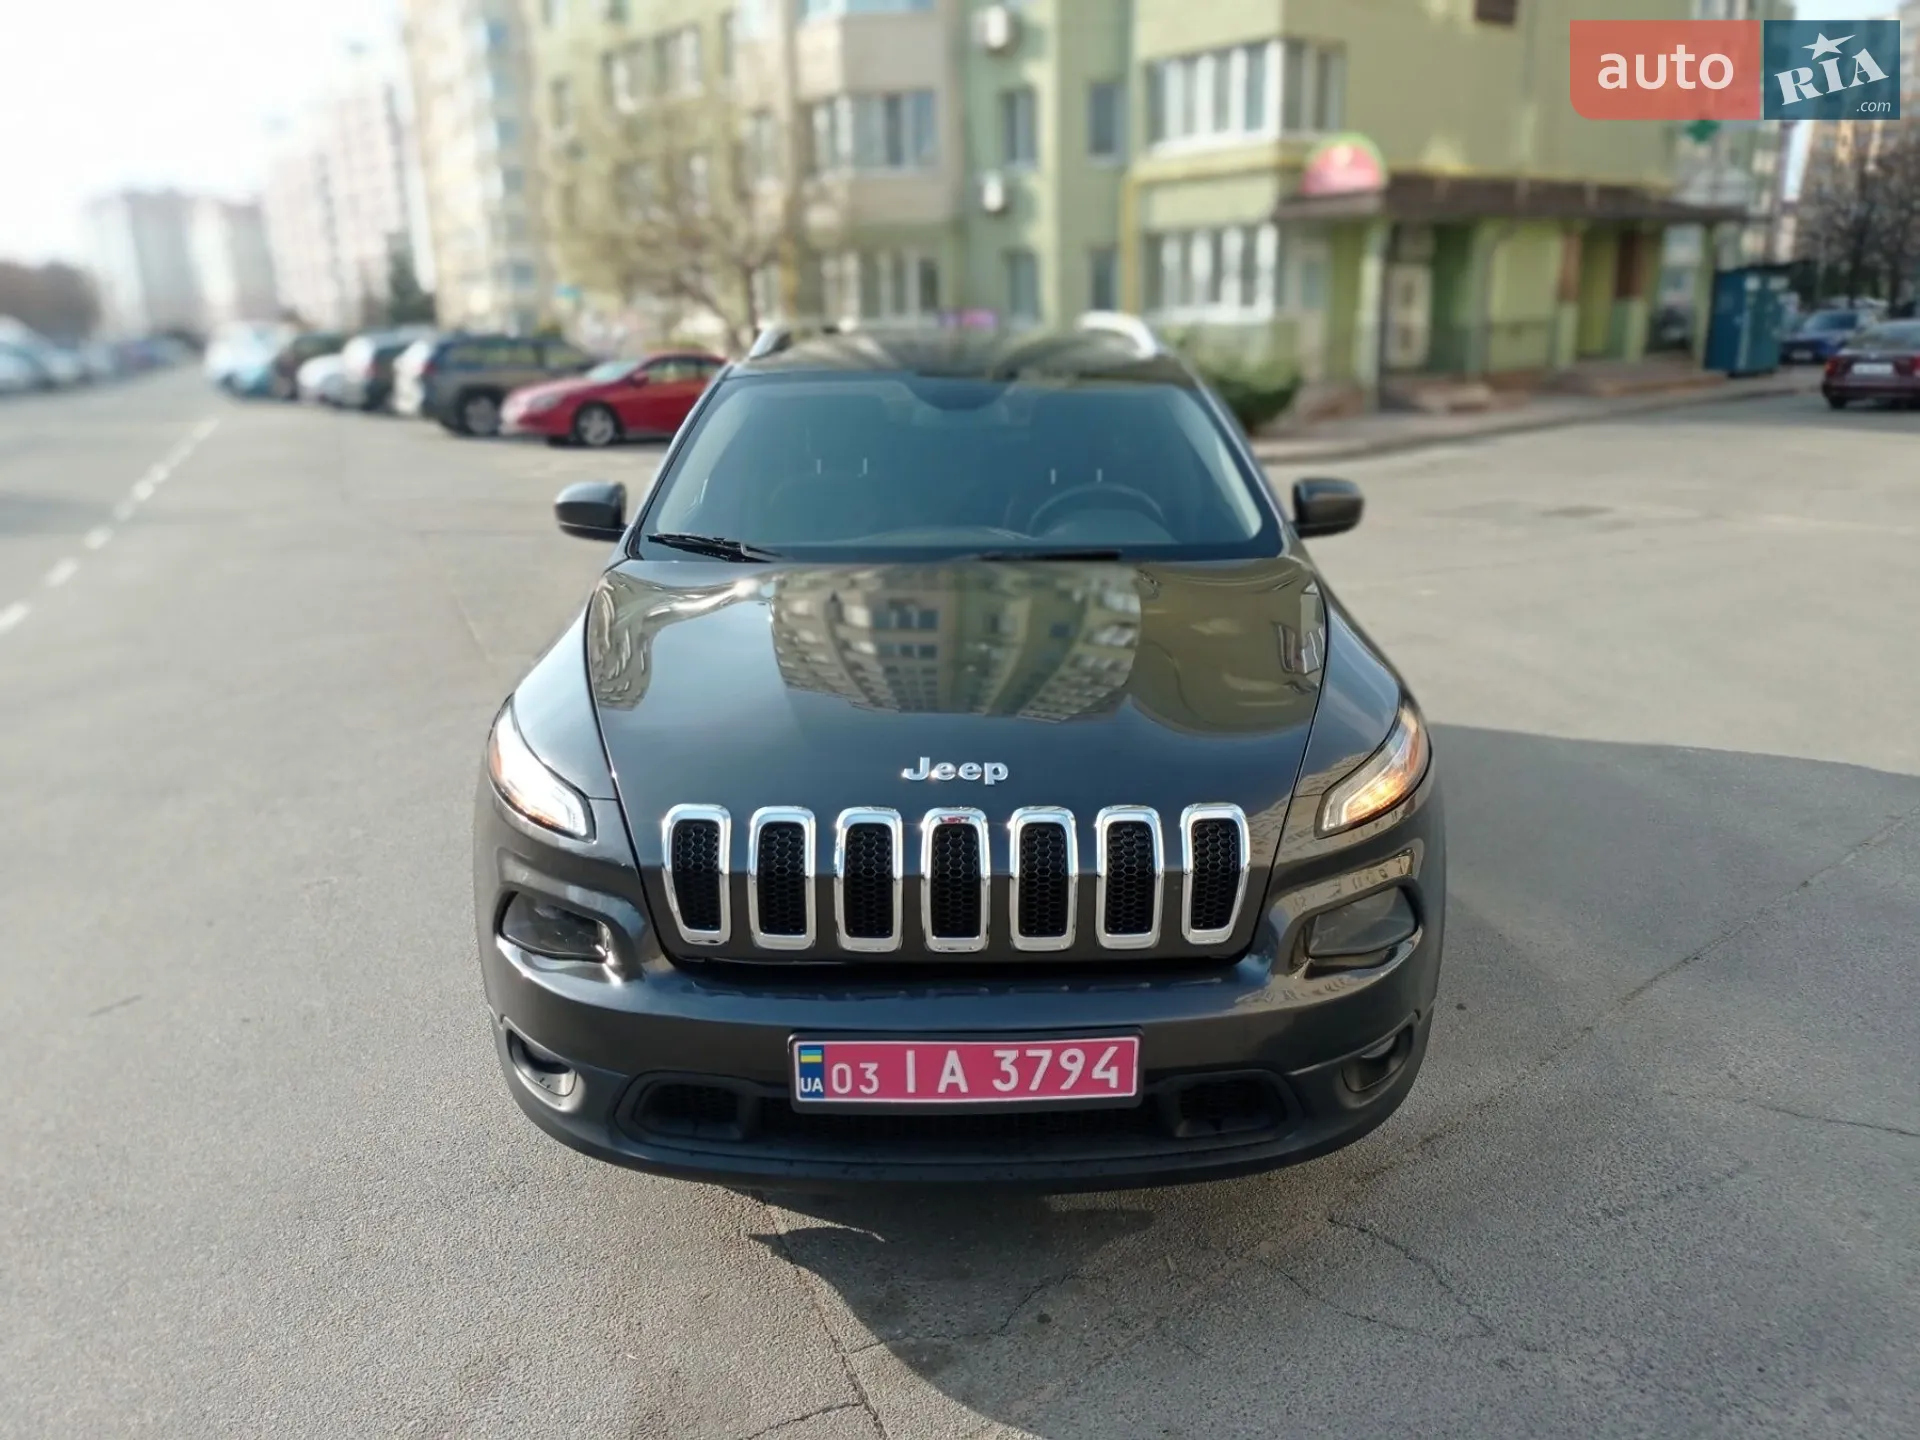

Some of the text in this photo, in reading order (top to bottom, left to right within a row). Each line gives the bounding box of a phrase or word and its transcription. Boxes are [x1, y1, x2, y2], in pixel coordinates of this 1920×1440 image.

[902, 757, 1008, 785] Jeep
[831, 1062, 879, 1094] 03
[992, 1046, 1119, 1092] 3794
[800, 1077, 823, 1093] UA
